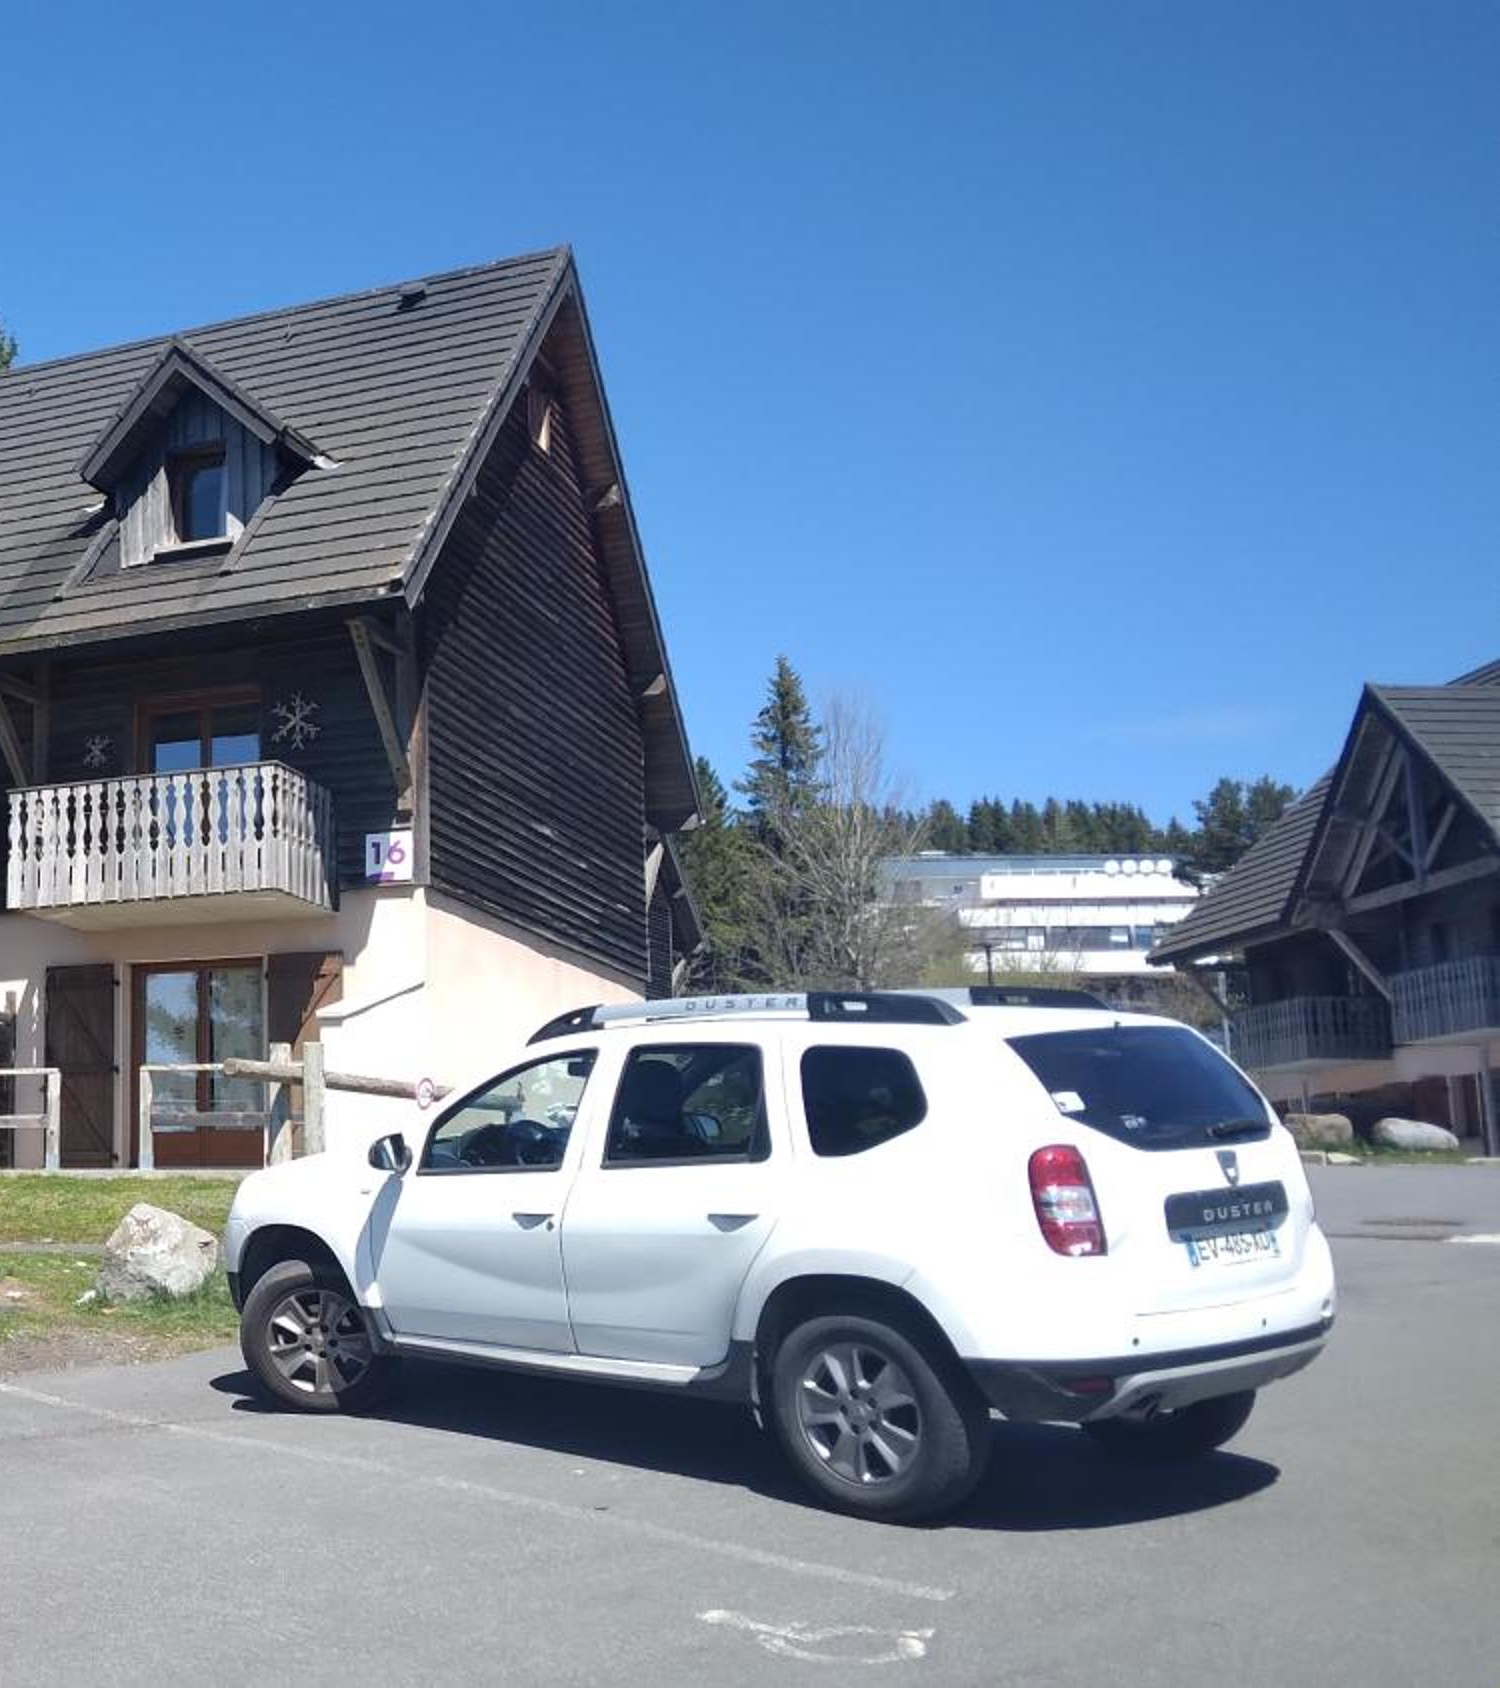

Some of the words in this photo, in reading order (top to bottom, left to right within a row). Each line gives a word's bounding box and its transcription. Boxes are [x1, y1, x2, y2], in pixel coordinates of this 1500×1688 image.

[371, 840, 406, 865] 16
[685, 997, 799, 1011] DUSTER
[1203, 1199, 1273, 1222] DUSTER
